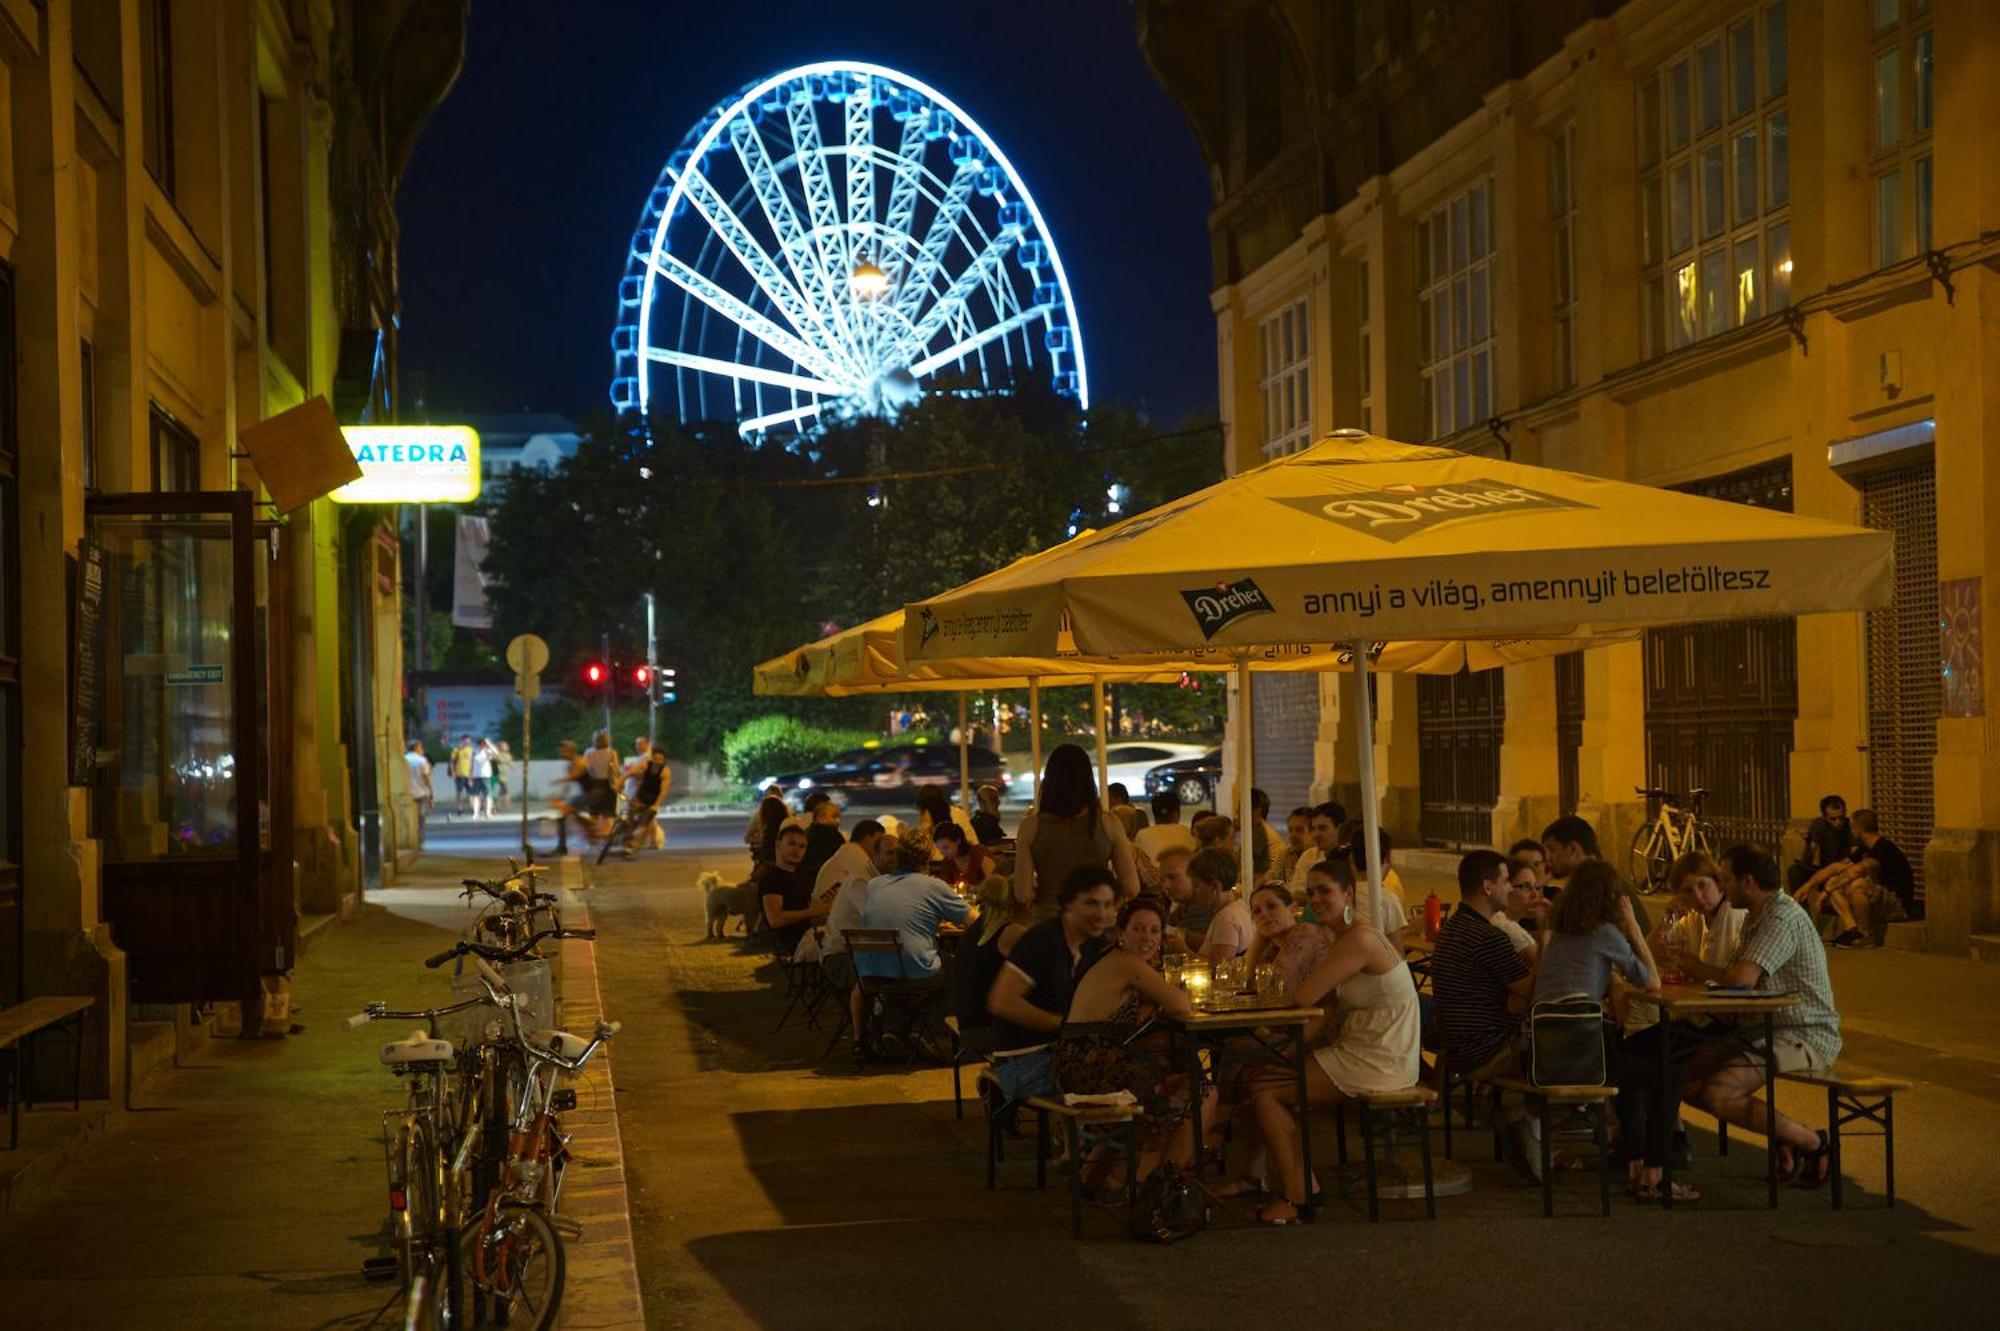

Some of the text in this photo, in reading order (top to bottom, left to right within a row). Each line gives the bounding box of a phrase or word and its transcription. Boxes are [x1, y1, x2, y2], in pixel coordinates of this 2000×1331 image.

[356, 444, 468, 463] ATEDRA
[1322, 488, 1548, 528] Dreher
[1194, 585, 1263, 624] Dreher
[1303, 565, 1772, 618] annyi a világ, amennyit beletöltesz
